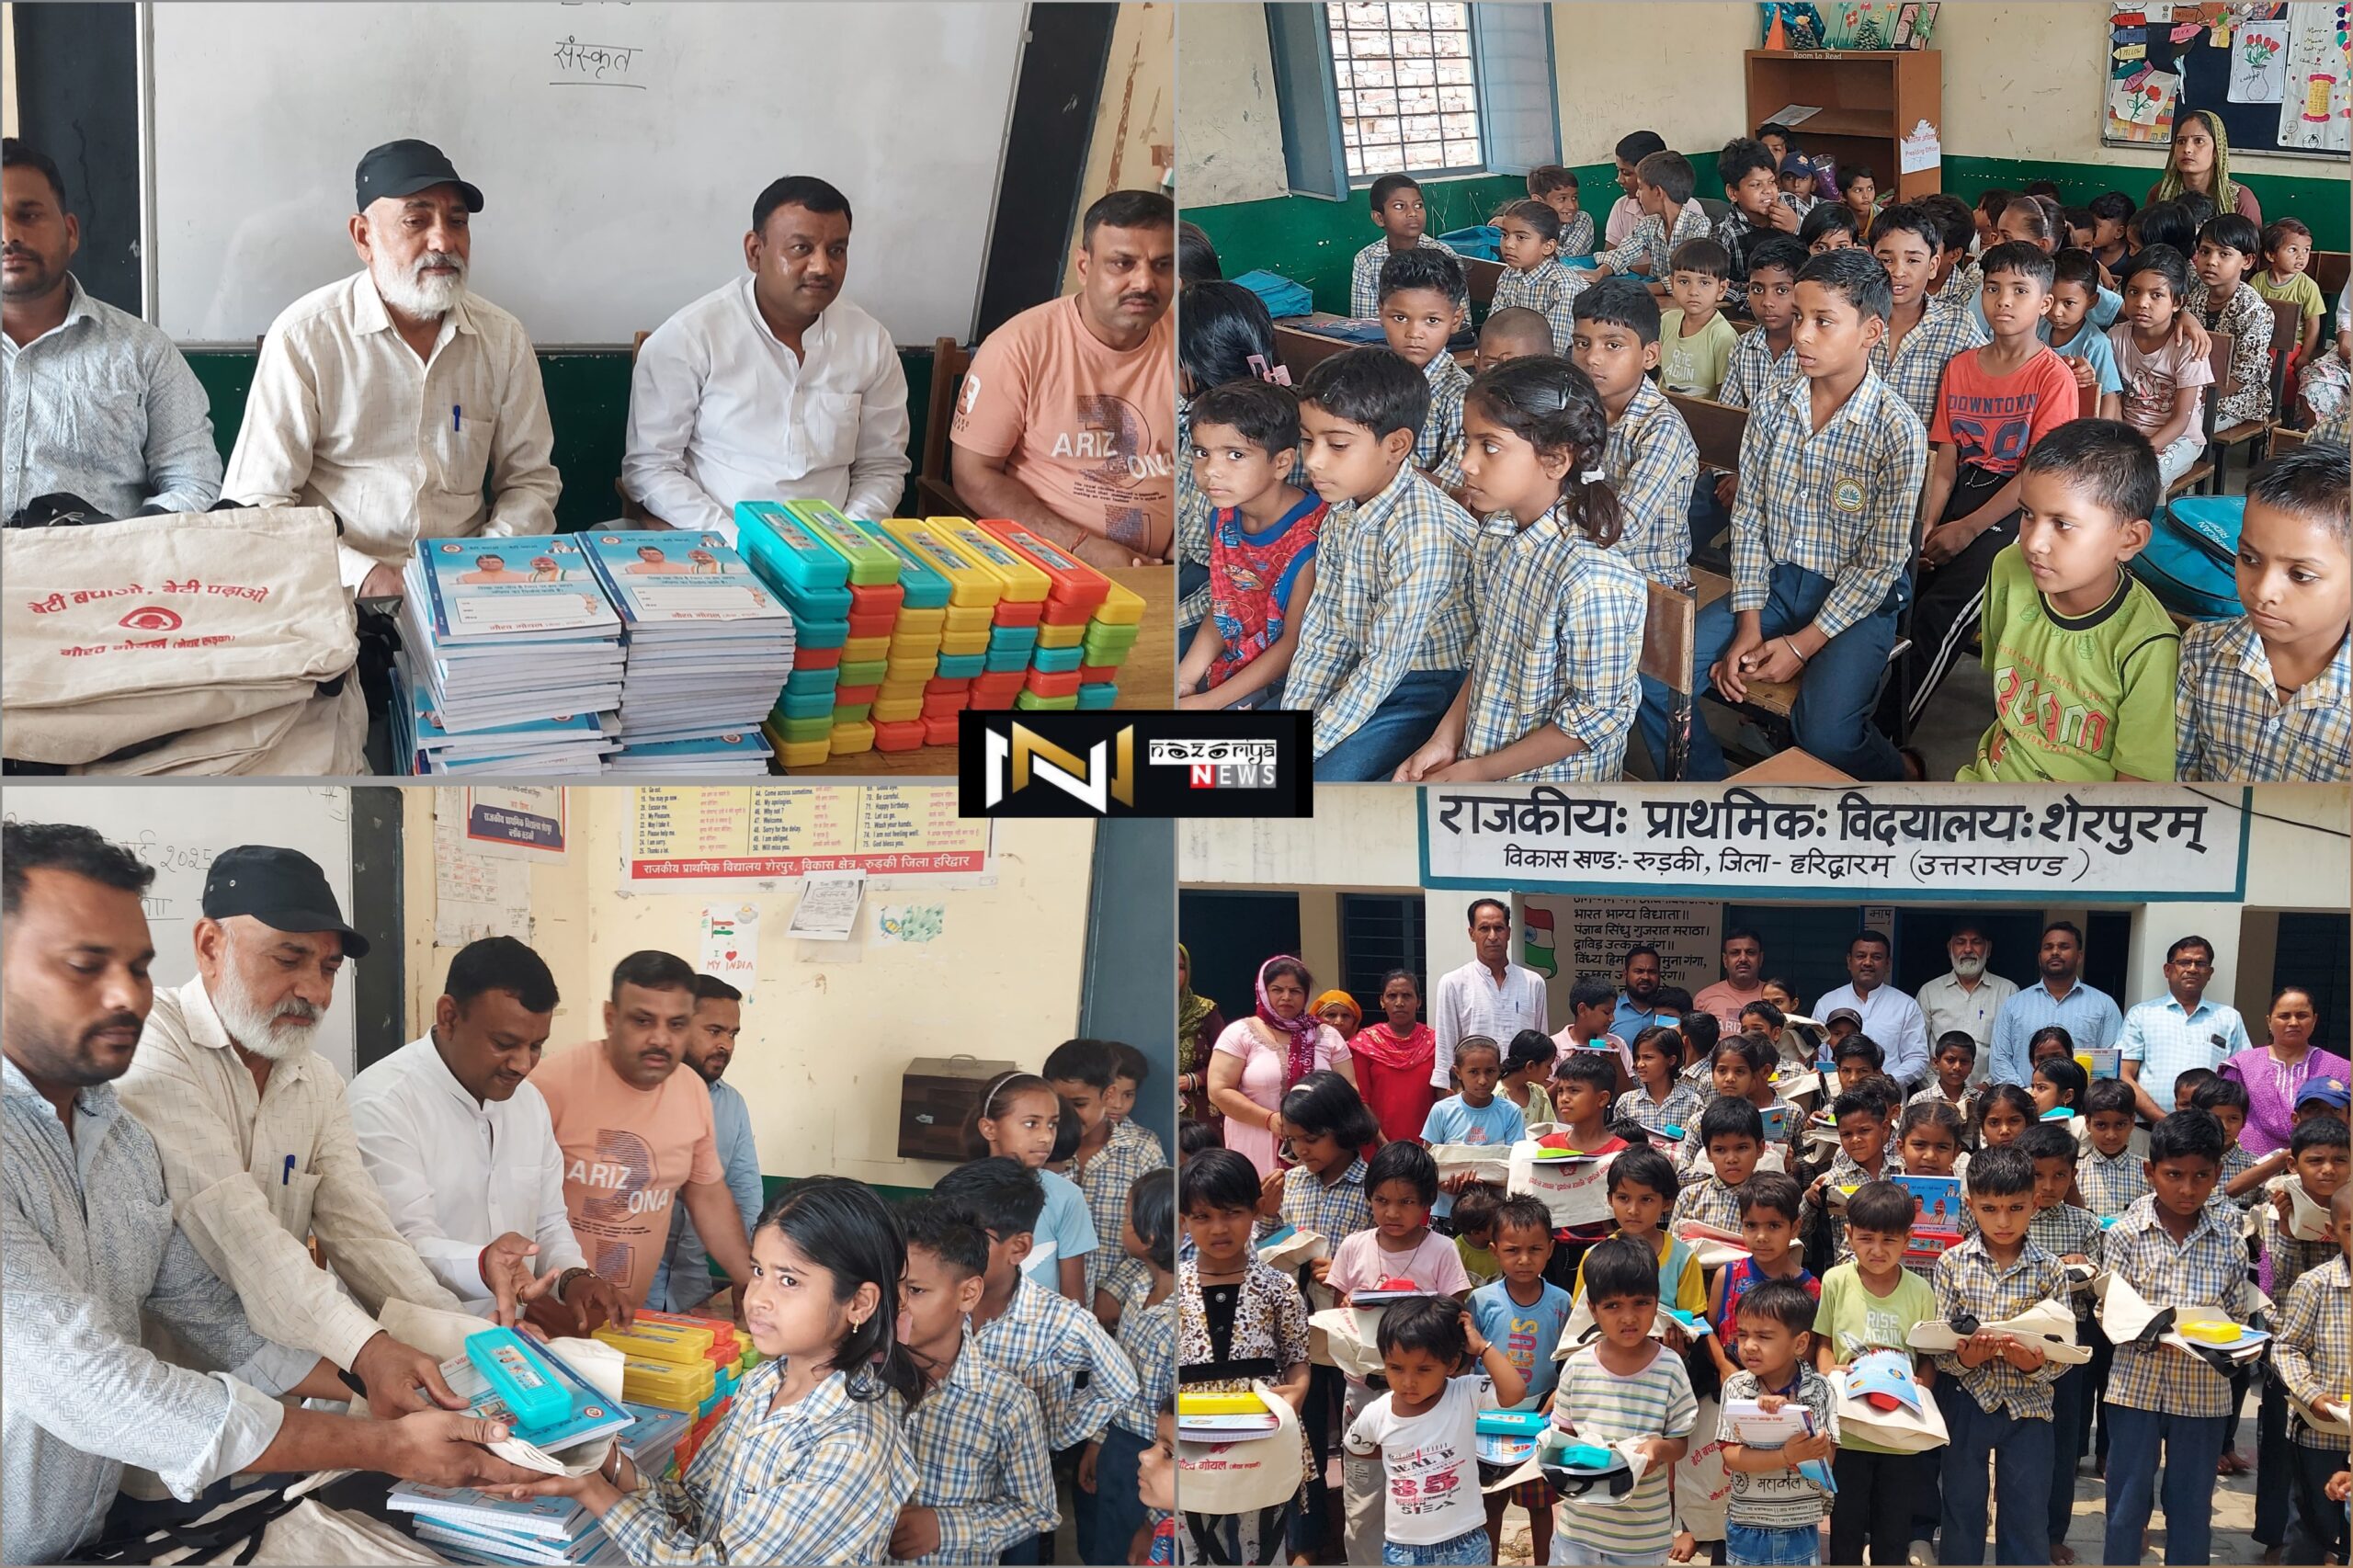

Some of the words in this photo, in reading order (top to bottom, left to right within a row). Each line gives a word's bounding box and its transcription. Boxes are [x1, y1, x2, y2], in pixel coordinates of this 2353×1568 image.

[554, 36, 642, 79] संस्कृत
[1665, 362, 1694, 381] AGAIN
[1949, 393, 2038, 413] DOWNTOWN
[1051, 432, 1118, 458] ARIZ
[28, 592, 67, 614] बेटी
[162, 579, 202, 594] बेटी
[207, 585, 271, 604] पढ़ाओ
[2039, 793, 2208, 855] शेरपुरम्
[892, 830, 908, 838] feeling
[642, 861, 678, 874] राजकीय
[683, 861, 720, 873] प्राथमिक
[723, 860, 761, 873] विद्यालय
[765, 859, 798, 874] शेरपुर,
[801, 858, 835, 870] विकास
[865, 855, 897, 871] रुड़की
[901, 856, 929, 869] जिला
[934, 855, 970, 868] हरिद्वार
[1504, 843, 1569, 869] विकास
[1790, 847, 1896, 879] हरिद्वारम्
[1574, 908, 1602, 919] भारत
[1606, 909, 1636, 920] भाग्य
[1574, 922, 1602, 935] पंजाब
[1605, 923, 1631, 938] सिंधु
[1633, 926, 1671, 937] गुजरात
[707, 960, 721, 970] MY
[726, 960, 754, 971] INDIA
[1574, 951, 1605, 964] विंध्य
[566, 1160, 632, 1190] ARIZ
[629, 1188, 670, 1214] ONA
[1867, 1312, 1899, 1328] RISE
[1863, 1327, 1902, 1344] AGAIN
[1199, 1459, 1227, 1471] गोयल
[1391, 1469, 1459, 1496] 35
